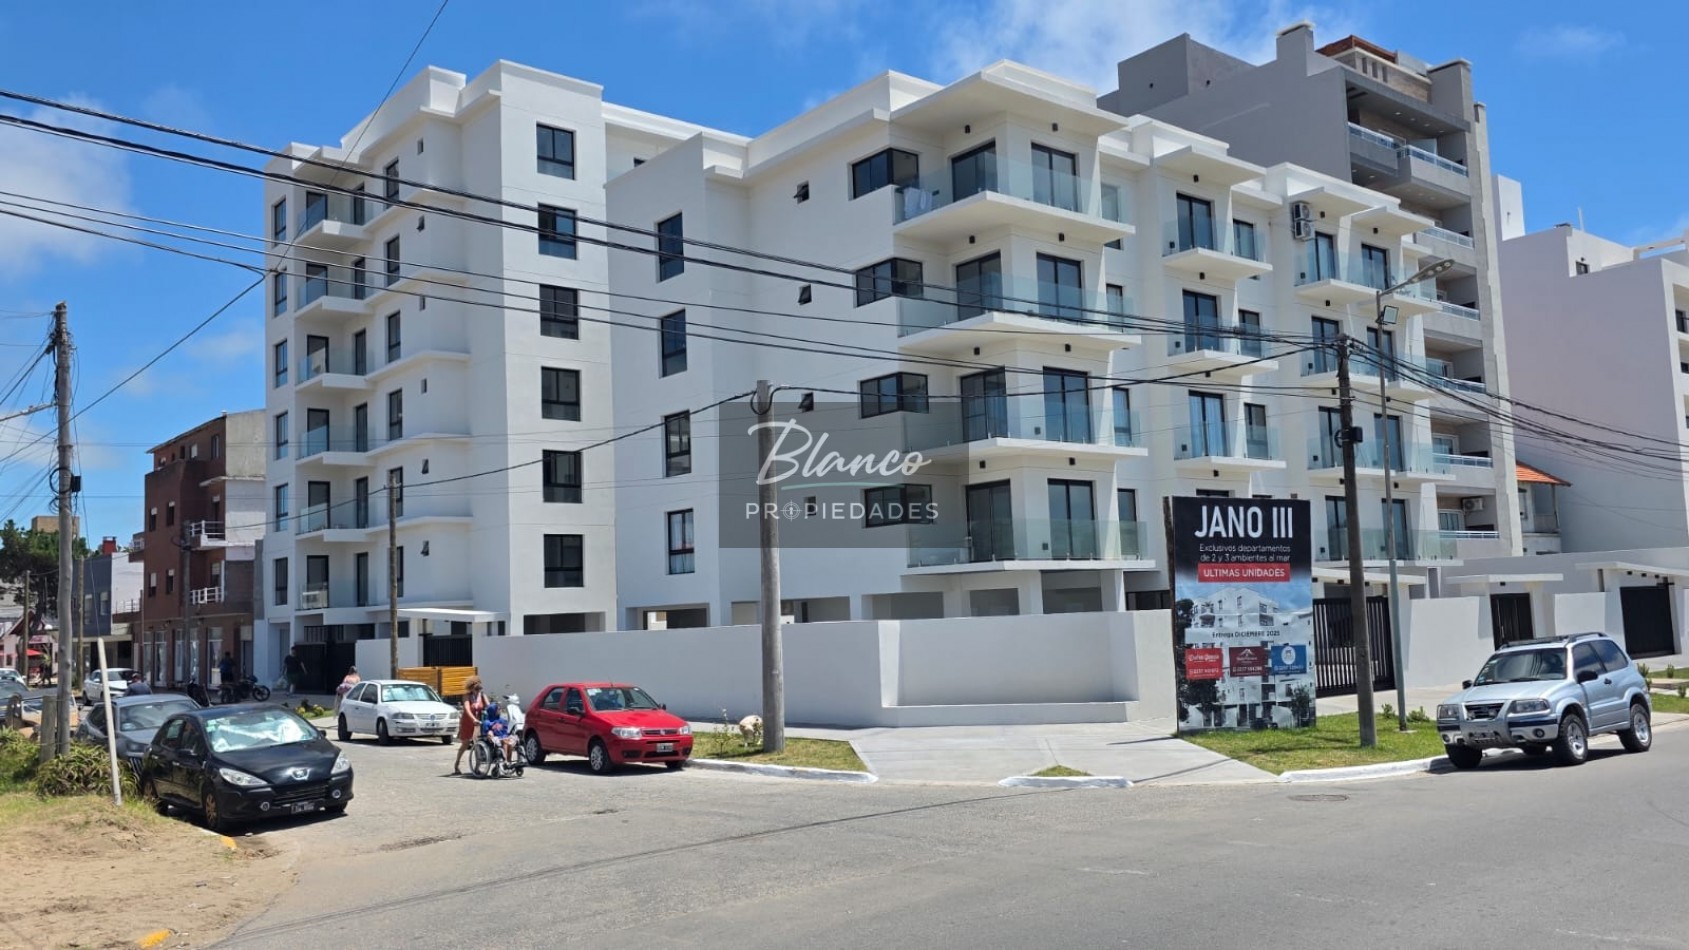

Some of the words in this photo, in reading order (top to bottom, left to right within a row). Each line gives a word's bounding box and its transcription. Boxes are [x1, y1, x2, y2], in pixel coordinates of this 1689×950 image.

[1194, 505, 1262, 538] JANO
[1272, 506, 1293, 539] III
[1200, 543, 1236, 552] Exclusivos
[1238, 543, 1291, 553] departamentos
[1200, 553, 1210, 561] de
[1212, 553, 1216, 562] 2
[1225, 553, 1230, 562] 3
[1231, 553, 1267, 562] ambientes
[1269, 553, 1275, 562] al
[1203, 568, 1240, 577] ULTIMAS
[1242, 568, 1285, 577] UNIDADES
